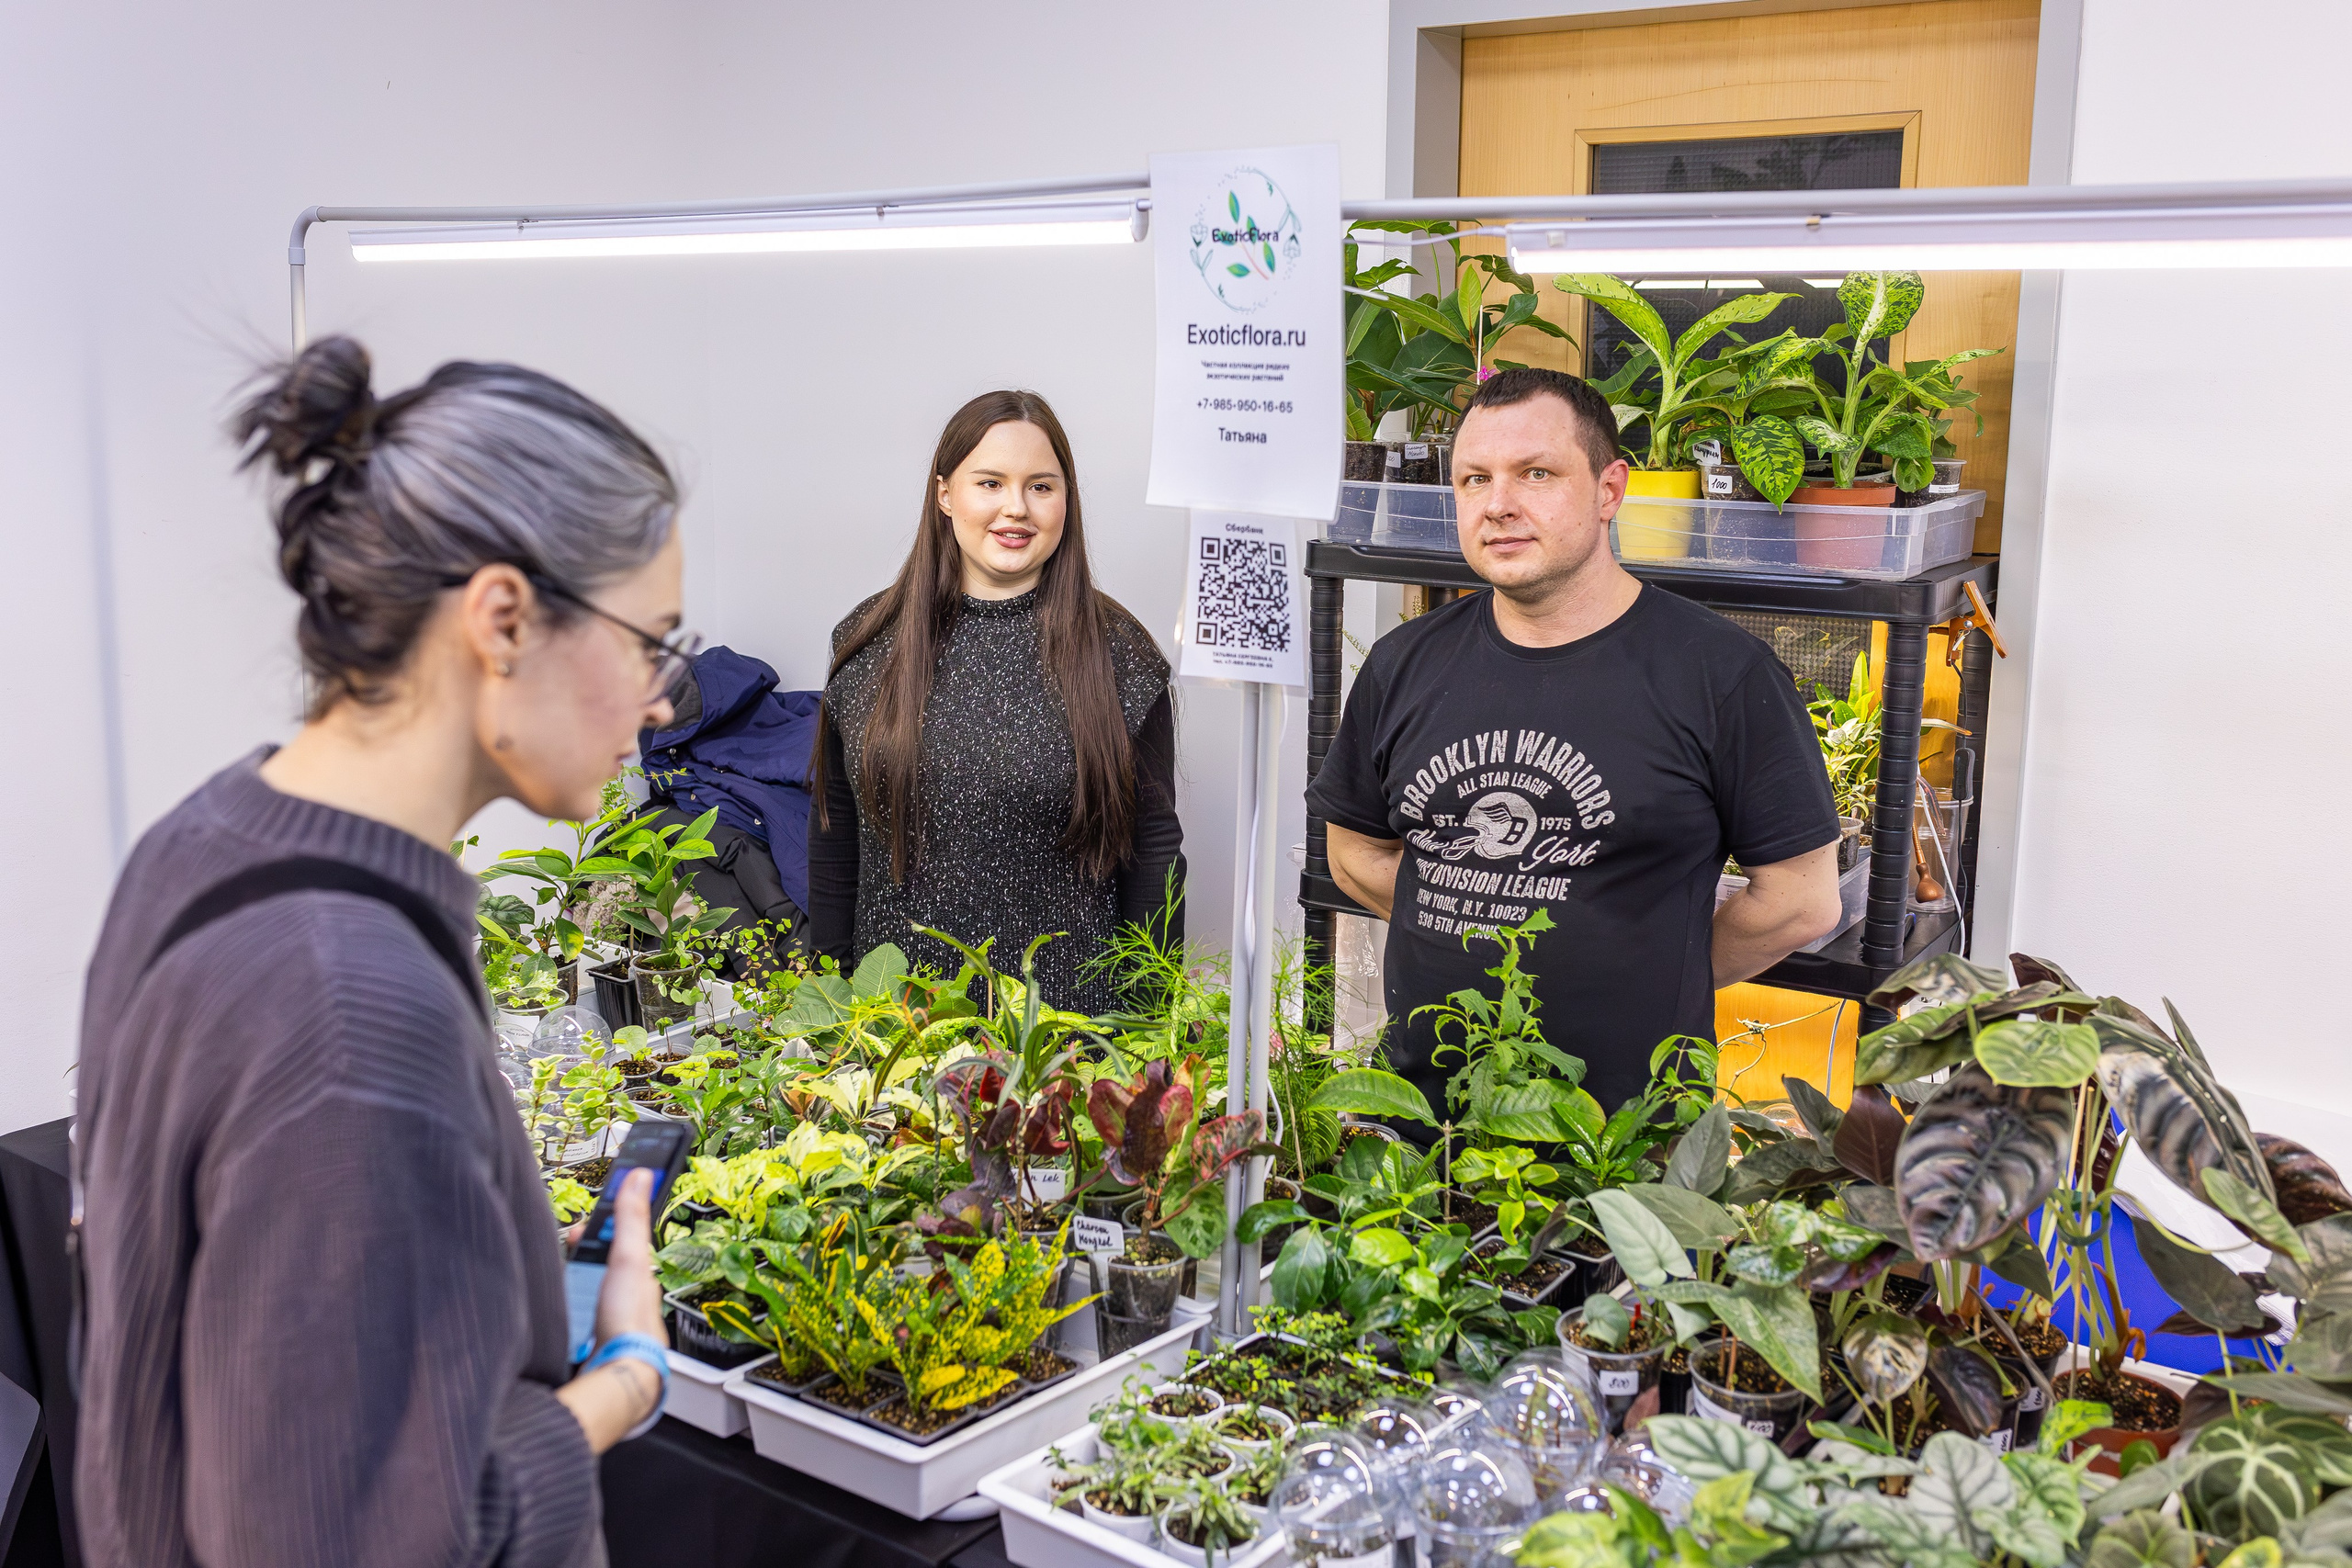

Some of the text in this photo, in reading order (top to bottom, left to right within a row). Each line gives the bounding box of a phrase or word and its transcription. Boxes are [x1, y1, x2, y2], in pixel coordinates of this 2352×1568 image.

[1188, 324, 1306, 346] Exoticflora.ru
[1218, 427, 1268, 444] Татьяна
[1712, 478, 1727, 490] 1000
[1400, 729, 1616, 830] BROOKLYN WARRIORS
[1456, 771, 1553, 800] ALL STAR LEAGUE
[1540, 817, 1572, 830] 1975
[1518, 836, 1601, 872] York
[1430, 863, 1502, 896] DIVISION
[1502, 874, 1571, 901] LEAGUE
[1431, 893, 1459, 915] YORK,
[1462, 899, 1484, 918] N.Y.
[1487, 903, 1528, 921] 10023
[1434, 916, 1454, 934] 5TH
